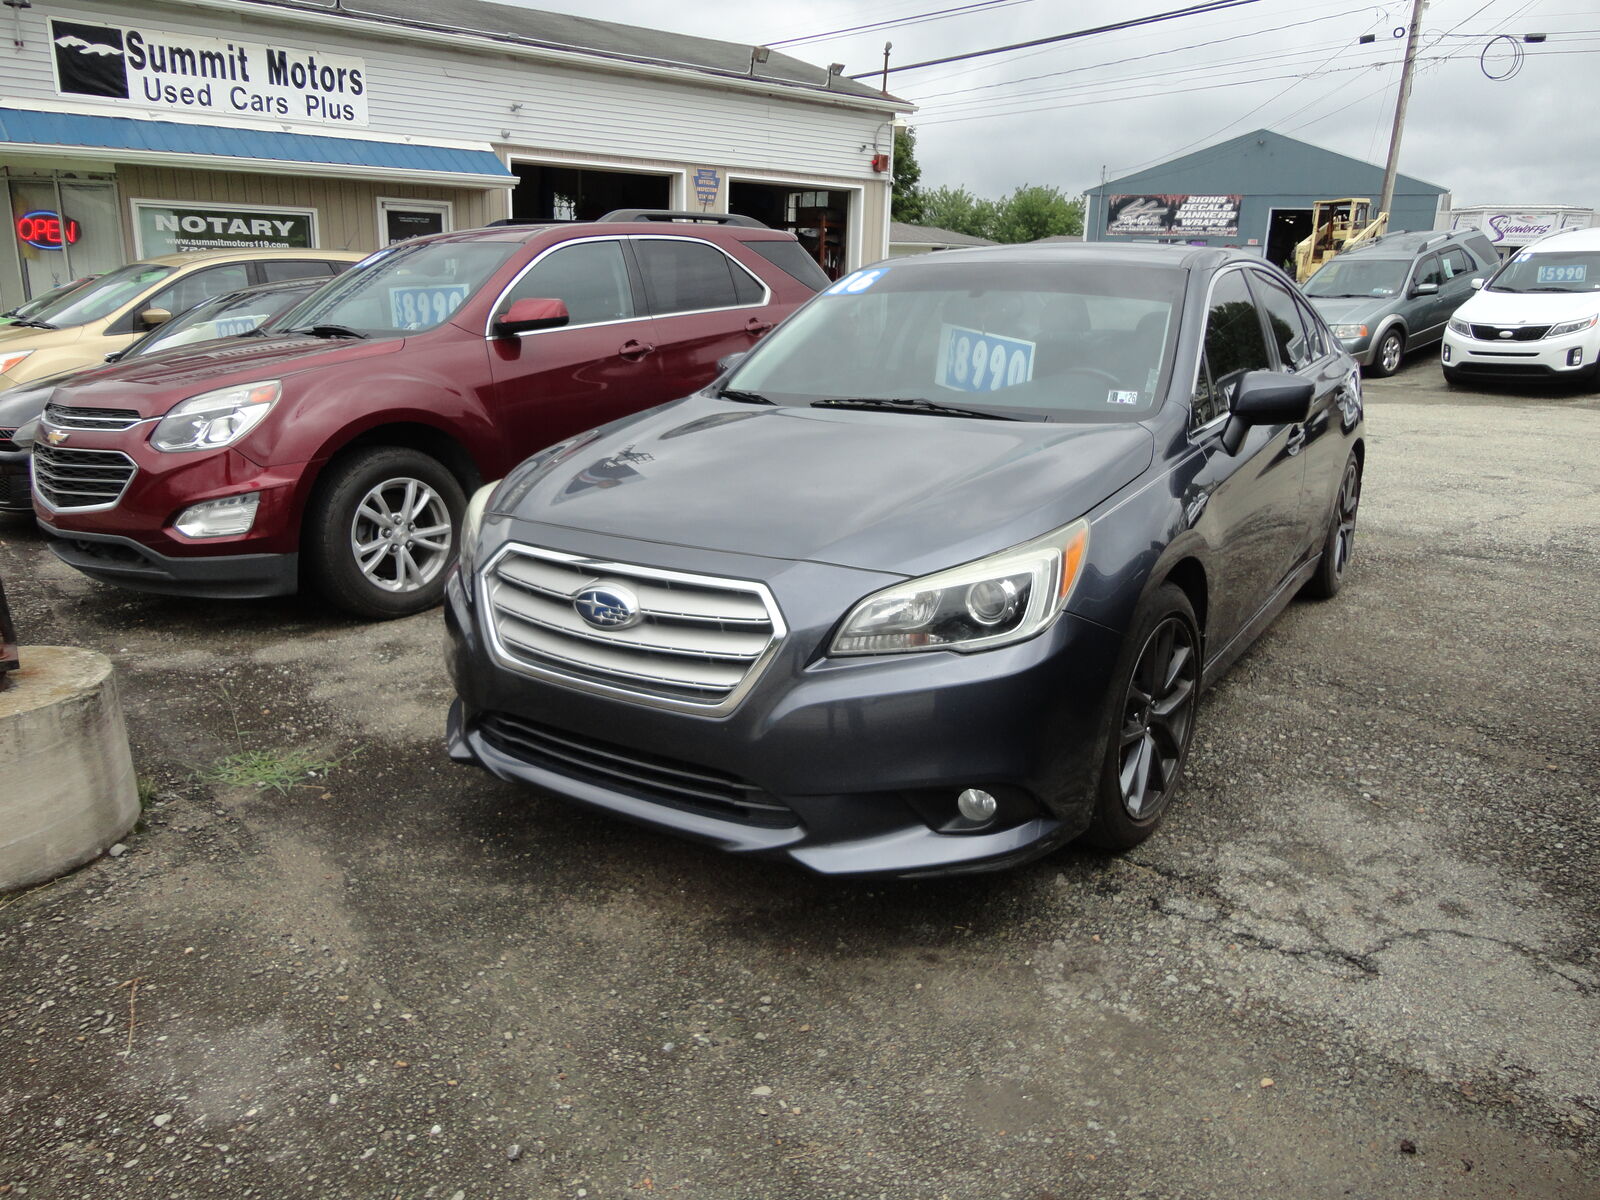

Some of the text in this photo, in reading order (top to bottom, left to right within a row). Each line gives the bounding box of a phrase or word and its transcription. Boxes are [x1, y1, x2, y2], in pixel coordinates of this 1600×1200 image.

[126, 30, 364, 96] Summit Motors
[143, 77, 355, 121] Used Cars Plus
[1180, 203, 1234, 211] DECALS
[1187, 195, 1228, 204] SIGNS
[1174, 211, 1237, 219] BANNERS
[18, 218, 76, 244] OPEN
[155, 214, 295, 237] NOTARY
[165, 238, 290, 249] www.summitmotors119.com
